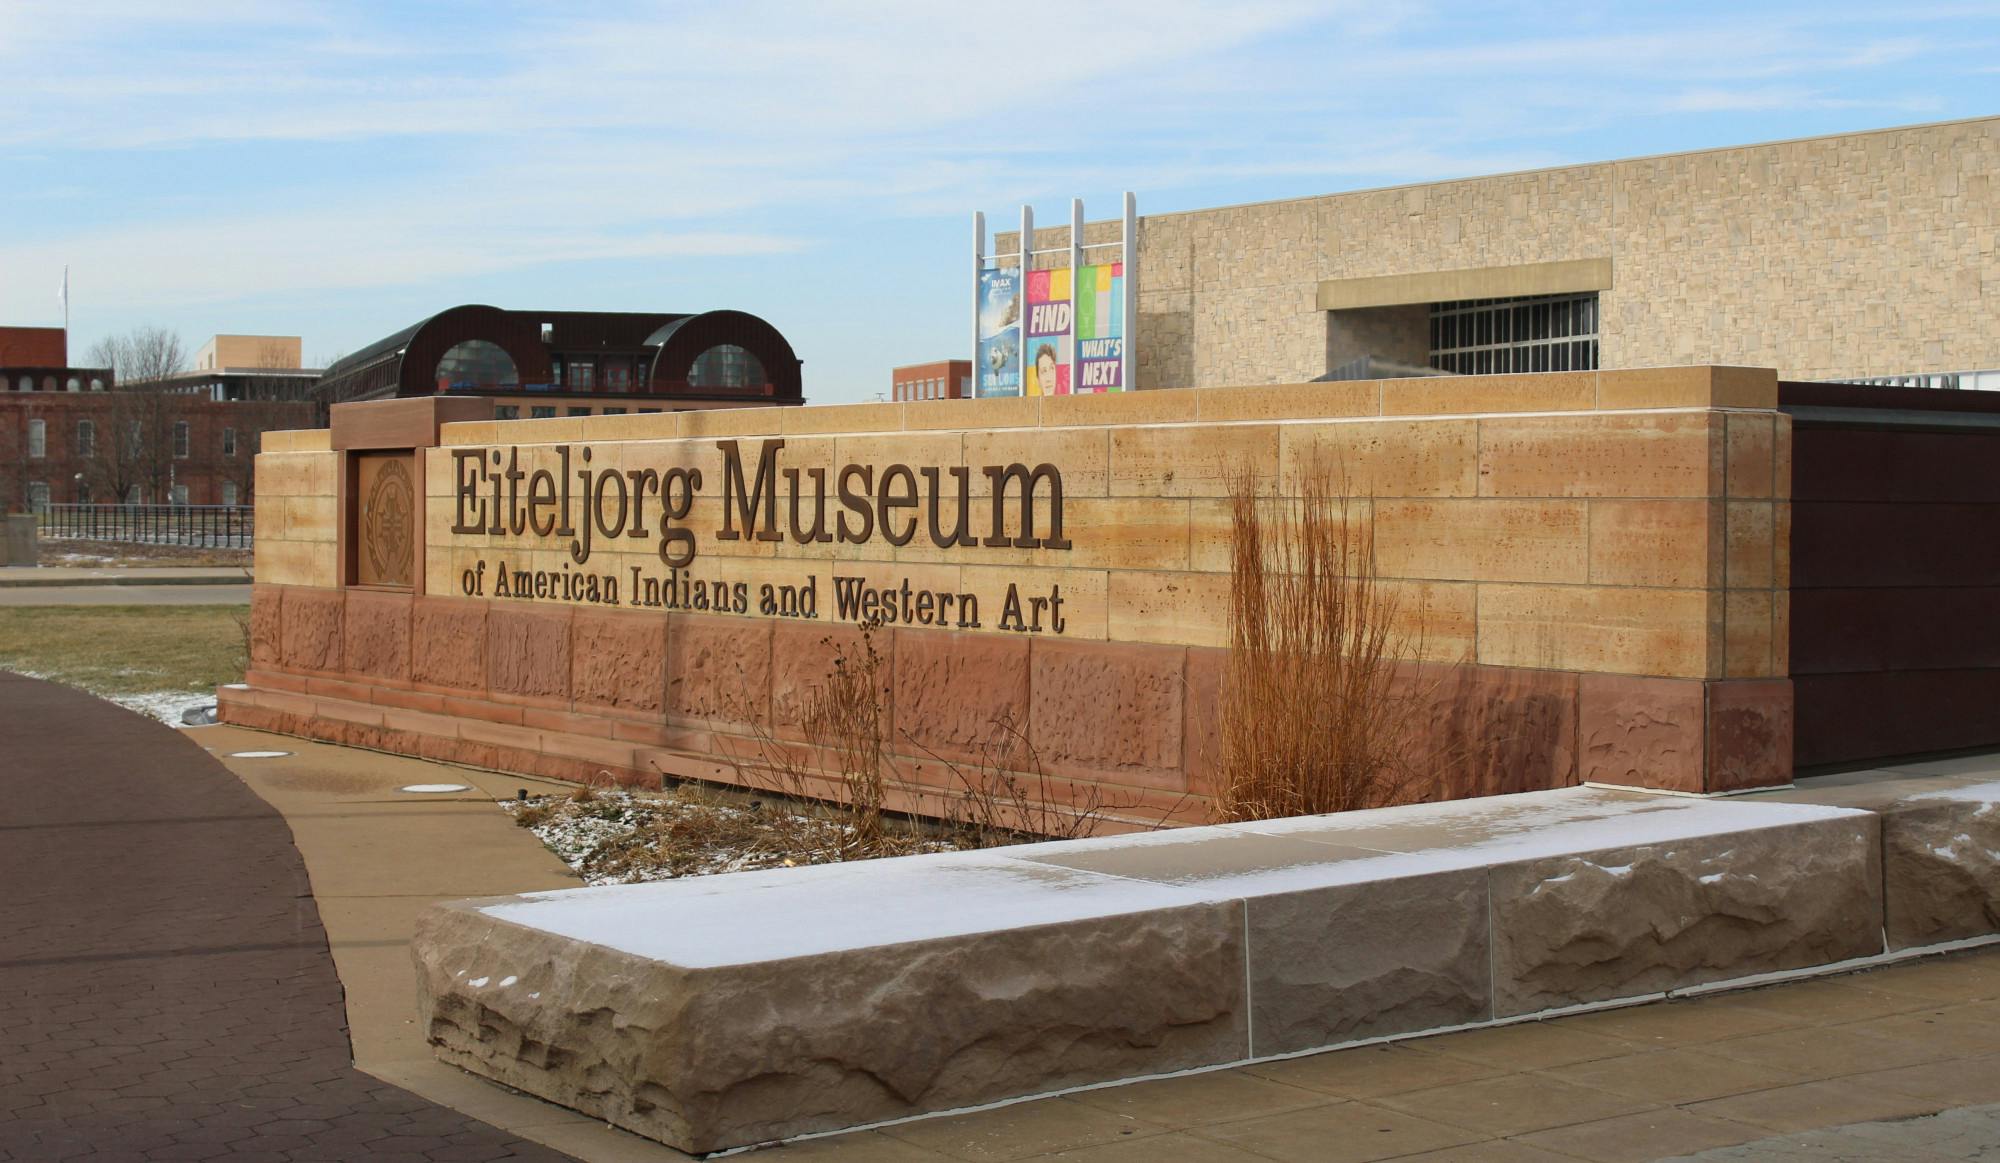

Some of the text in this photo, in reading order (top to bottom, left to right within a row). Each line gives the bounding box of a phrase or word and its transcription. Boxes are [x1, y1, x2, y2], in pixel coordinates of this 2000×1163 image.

[991, 278, 1011, 288] IMAX
[1030, 303, 1071, 334] FIND
[1082, 339, 1121, 358] WHAT'S
[1082, 360, 1119, 386] NEXT
[451, 438, 1072, 568] Eiteljorg Museum
[462, 559, 1065, 634] of American Indians and Western Art
